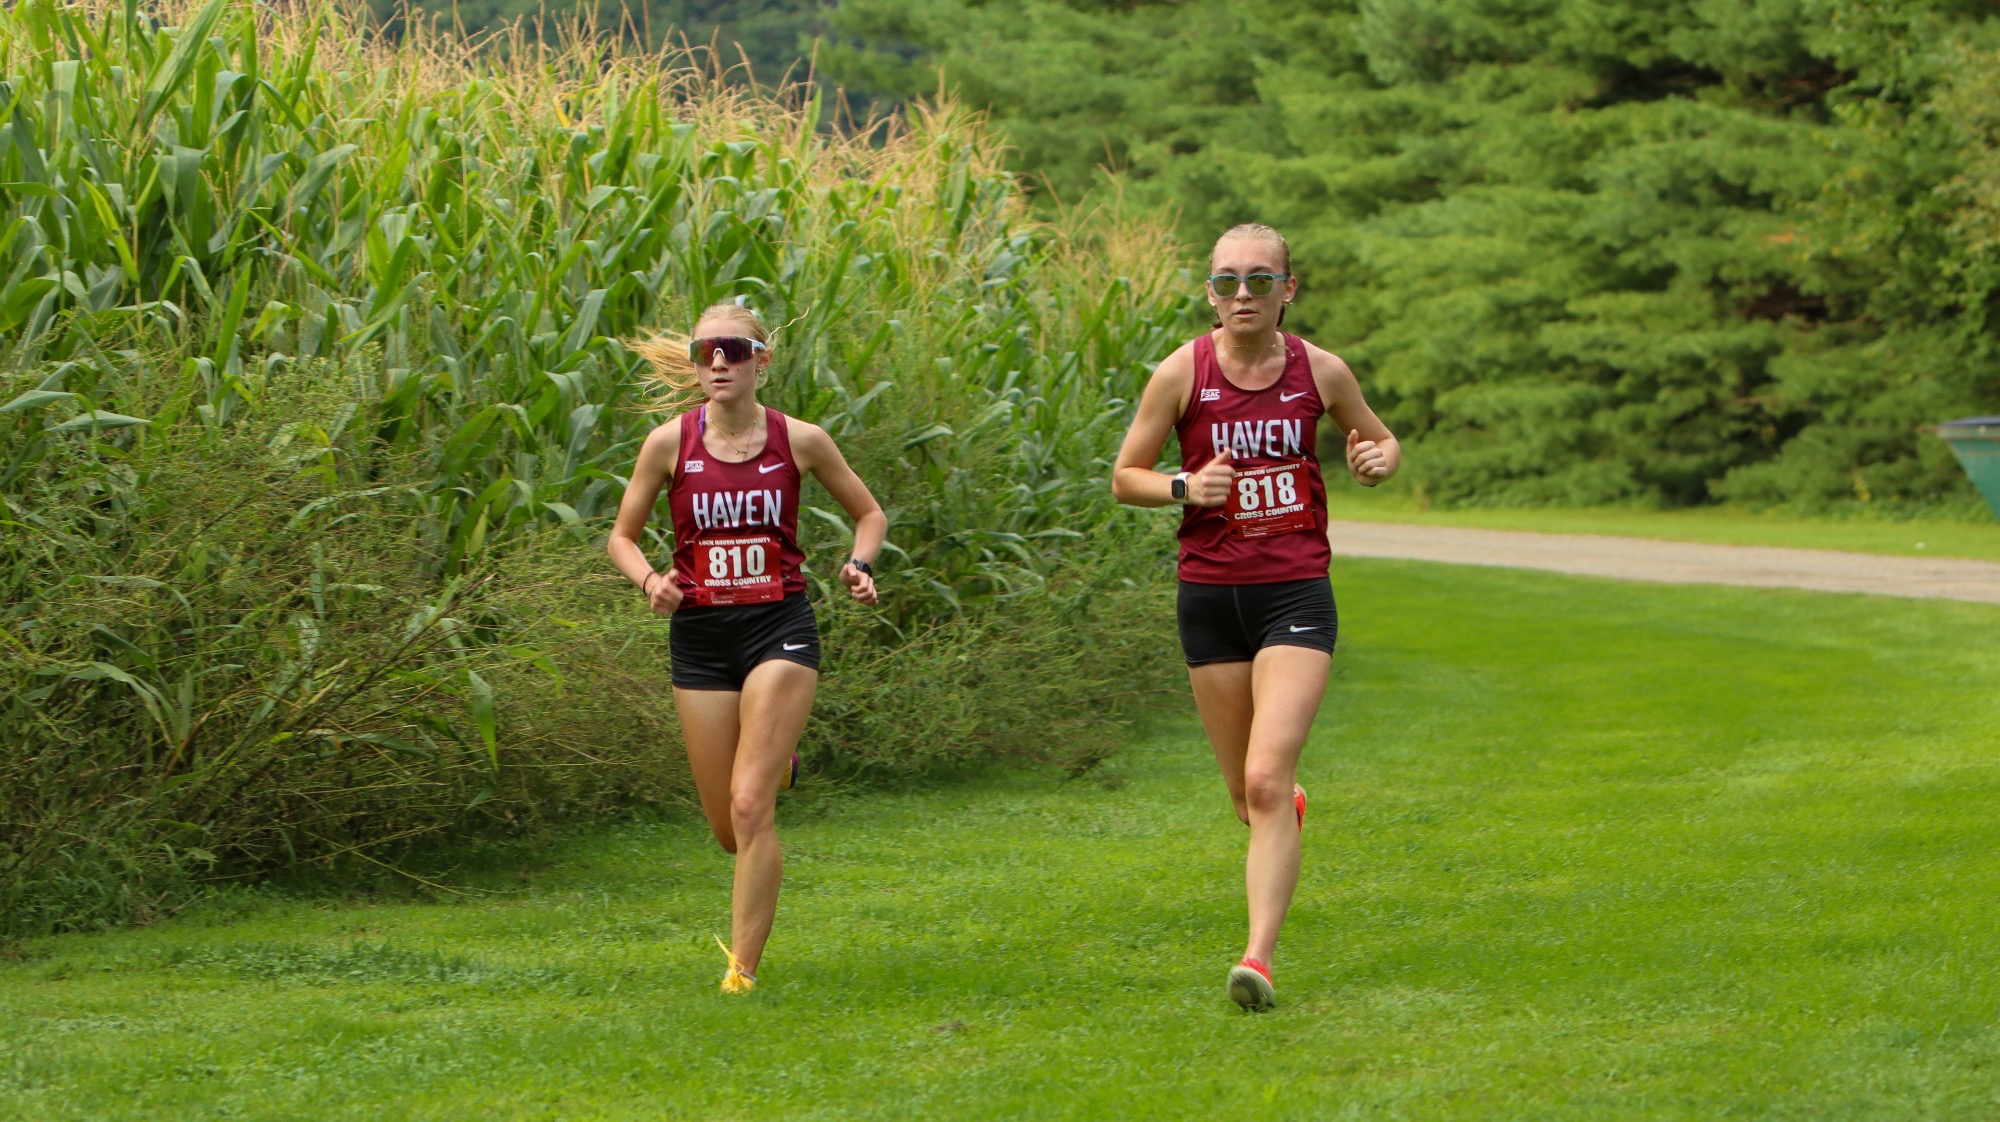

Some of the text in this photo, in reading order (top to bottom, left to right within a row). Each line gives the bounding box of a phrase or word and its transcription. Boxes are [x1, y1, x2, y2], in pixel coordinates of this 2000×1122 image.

[1211, 418, 1302, 460] HAVEN
[1244, 468, 1266, 477] HAVEN
[1266, 463, 1301, 474] UNIVERSITY
[1237, 472, 1297, 511] 818
[692, 489, 782, 530] HAVEN
[1234, 510, 1264, 520] CROSS
[1265, 503, 1304, 516] COUNTRY
[735, 537, 771, 545] UNIVERSITY
[708, 544, 766, 579] 810
[704, 575, 772, 587] CROSS COUNTRY
